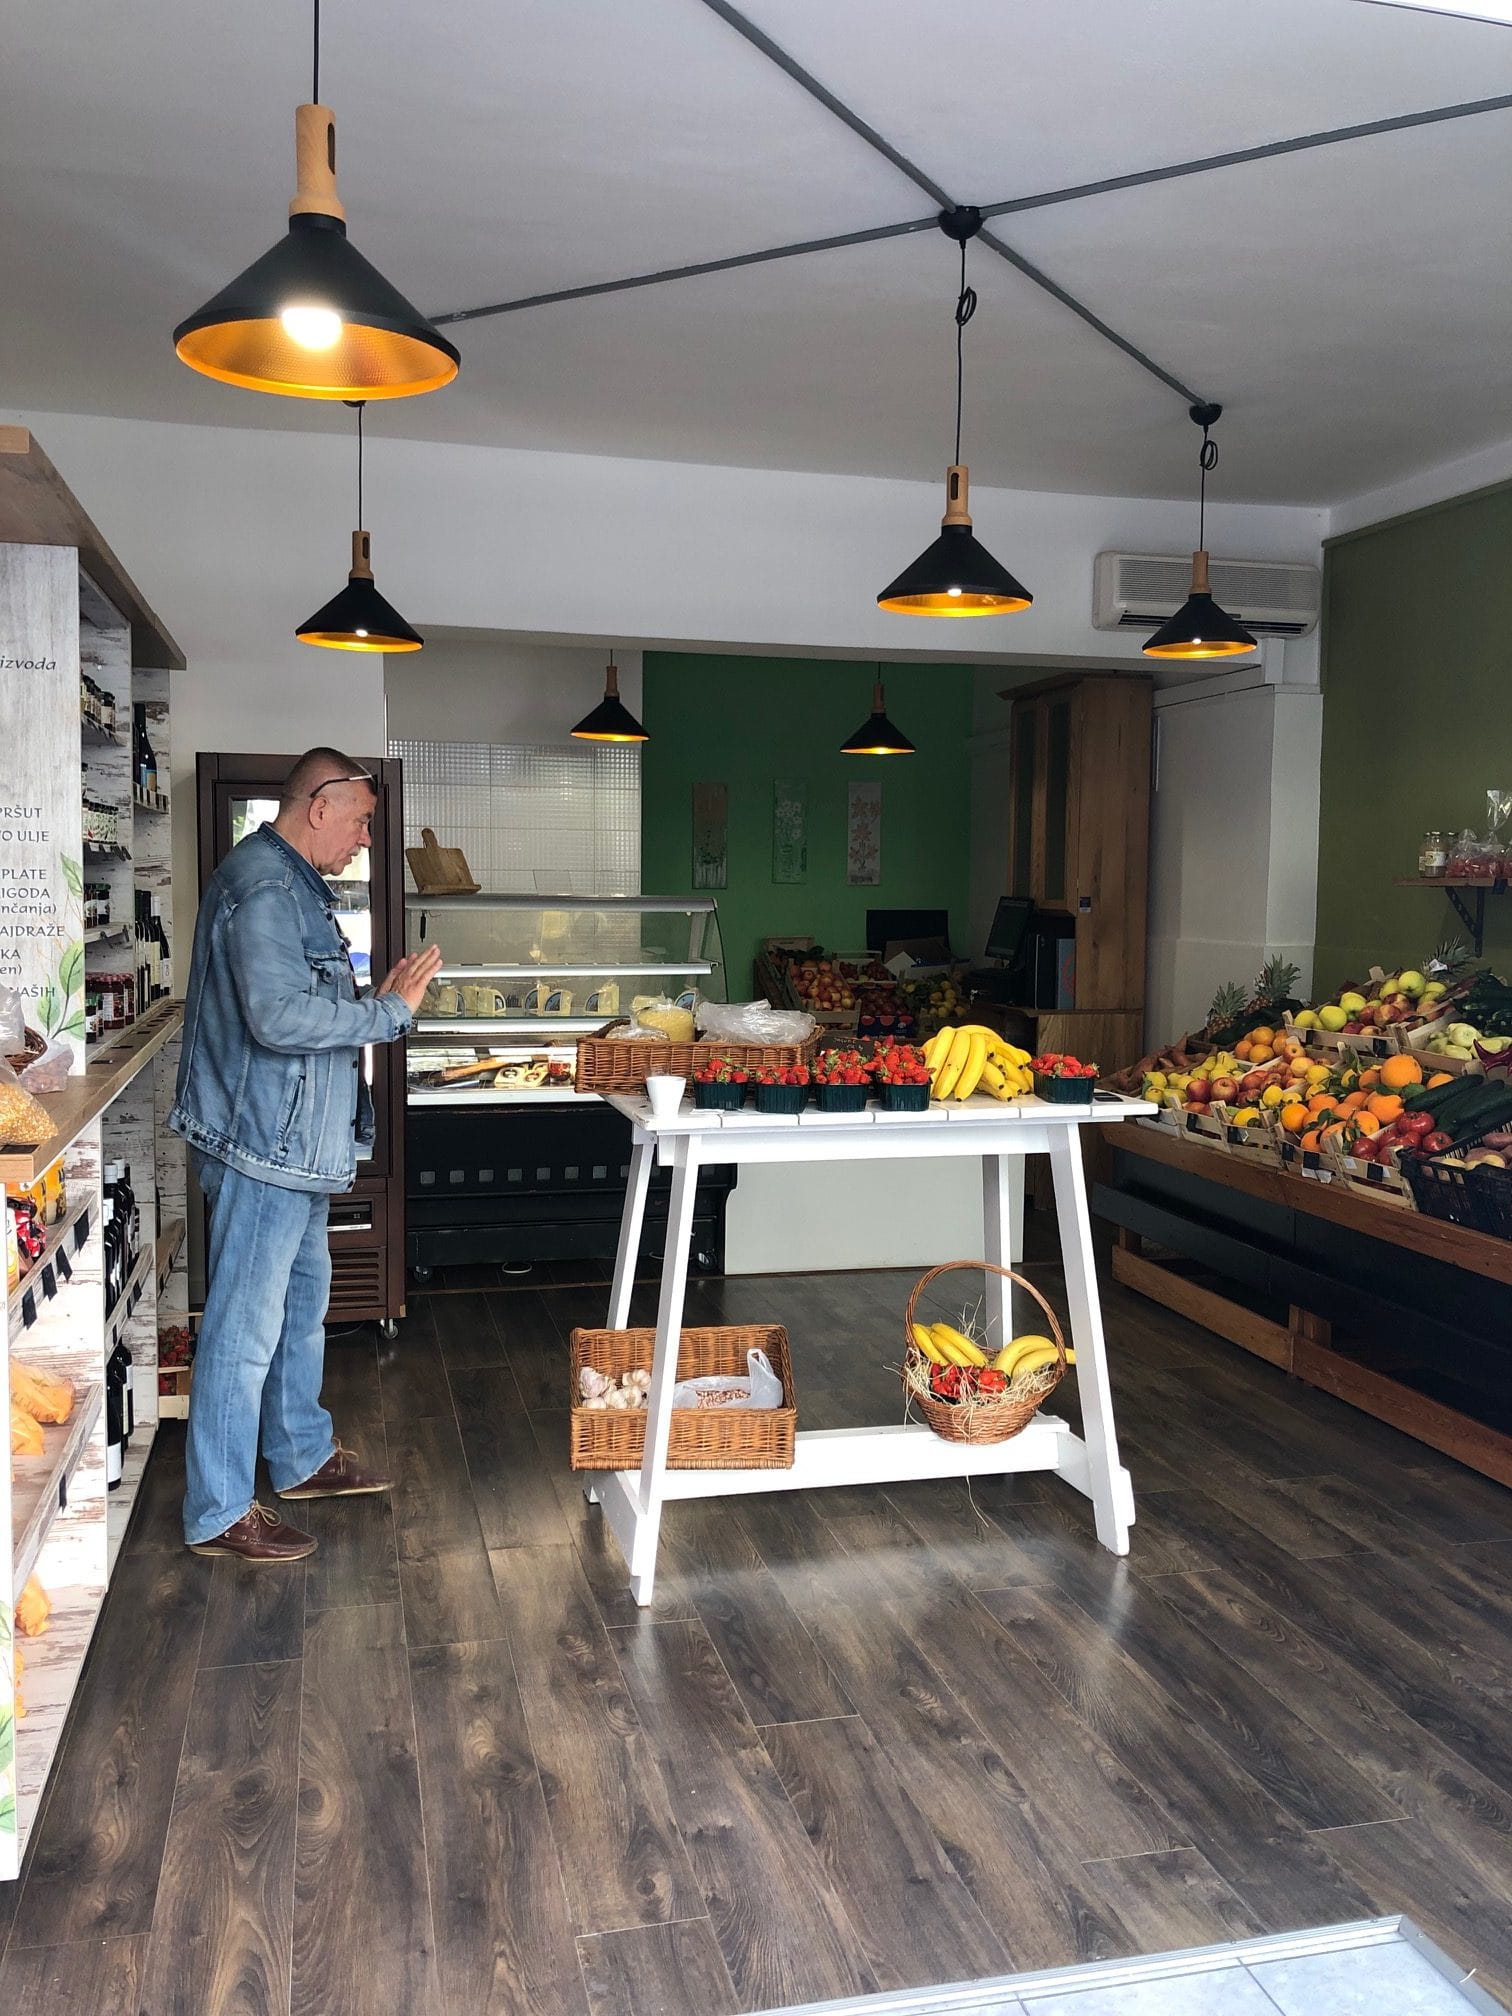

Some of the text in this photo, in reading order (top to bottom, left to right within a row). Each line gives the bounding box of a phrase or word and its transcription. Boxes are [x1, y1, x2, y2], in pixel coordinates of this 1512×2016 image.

[0, 655, 57, 671] izvoda
[17, 830, 50, 843] ULJE
[1, 902, 57, 916] nčanja)
[0, 922, 65, 937] AJDRAŽE
